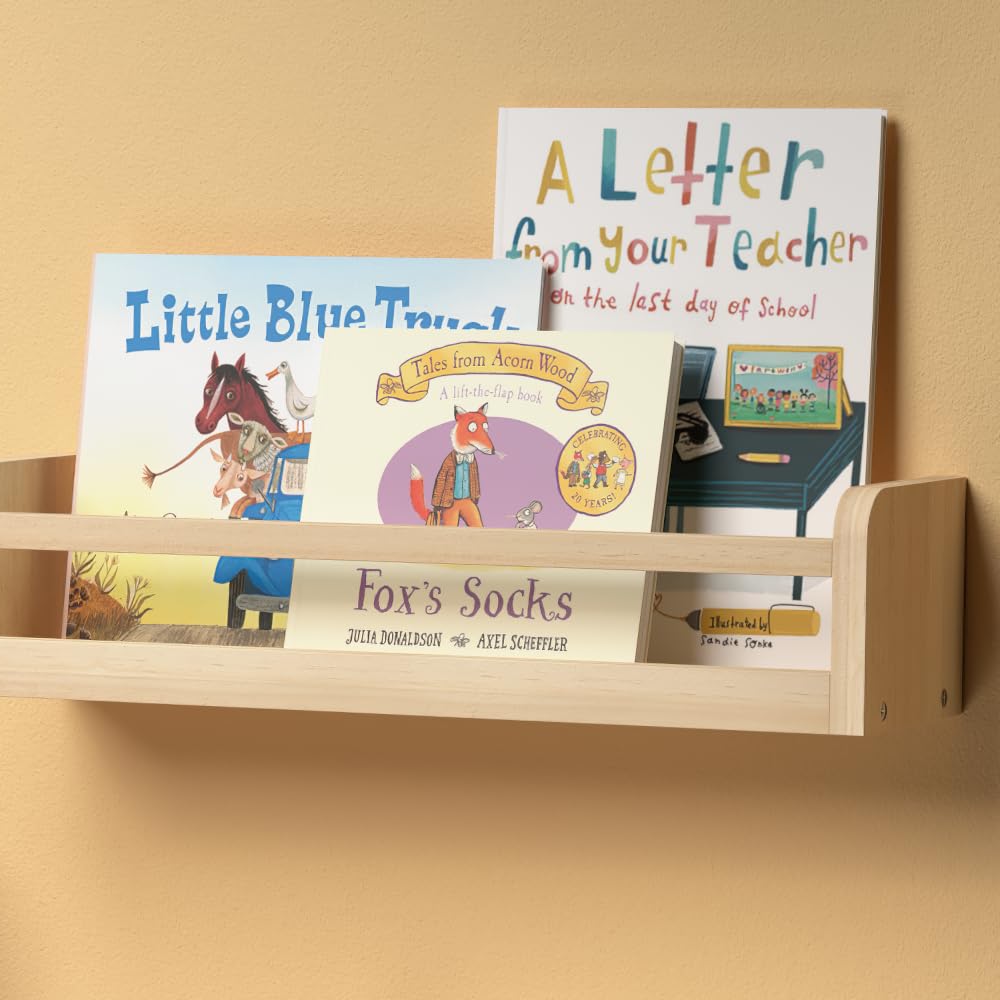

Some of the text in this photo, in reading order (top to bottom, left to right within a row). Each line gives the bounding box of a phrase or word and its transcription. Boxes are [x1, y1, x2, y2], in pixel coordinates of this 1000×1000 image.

[536, 121, 824, 205] A Letter
[695, 207, 868, 270] Teacher
[551, 288, 575, 305] on
[583, 286, 617, 310] the
[629, 282, 671, 312] last
[685, 289, 717, 323] day
[728, 298, 751, 320] of
[125, 288, 251, 353] Little
[265, 283, 366, 343] Blue
[411, 347, 579, 384] Tales from Acorn Wood
[439, 384, 543, 405] A lift-the-flap book
[572, 429, 627, 452] CELEBRATING
[571, 491, 617, 508] 20 YEARS!
[353, 567, 573, 622] Fox's Socks
[710, 616, 768, 631] Illustrated by
[345, 628, 443, 648] JULIA DONALDSON
[477, 633, 568, 652] AXEL SCHEFFLER
[700, 634, 739, 647] Sandie
